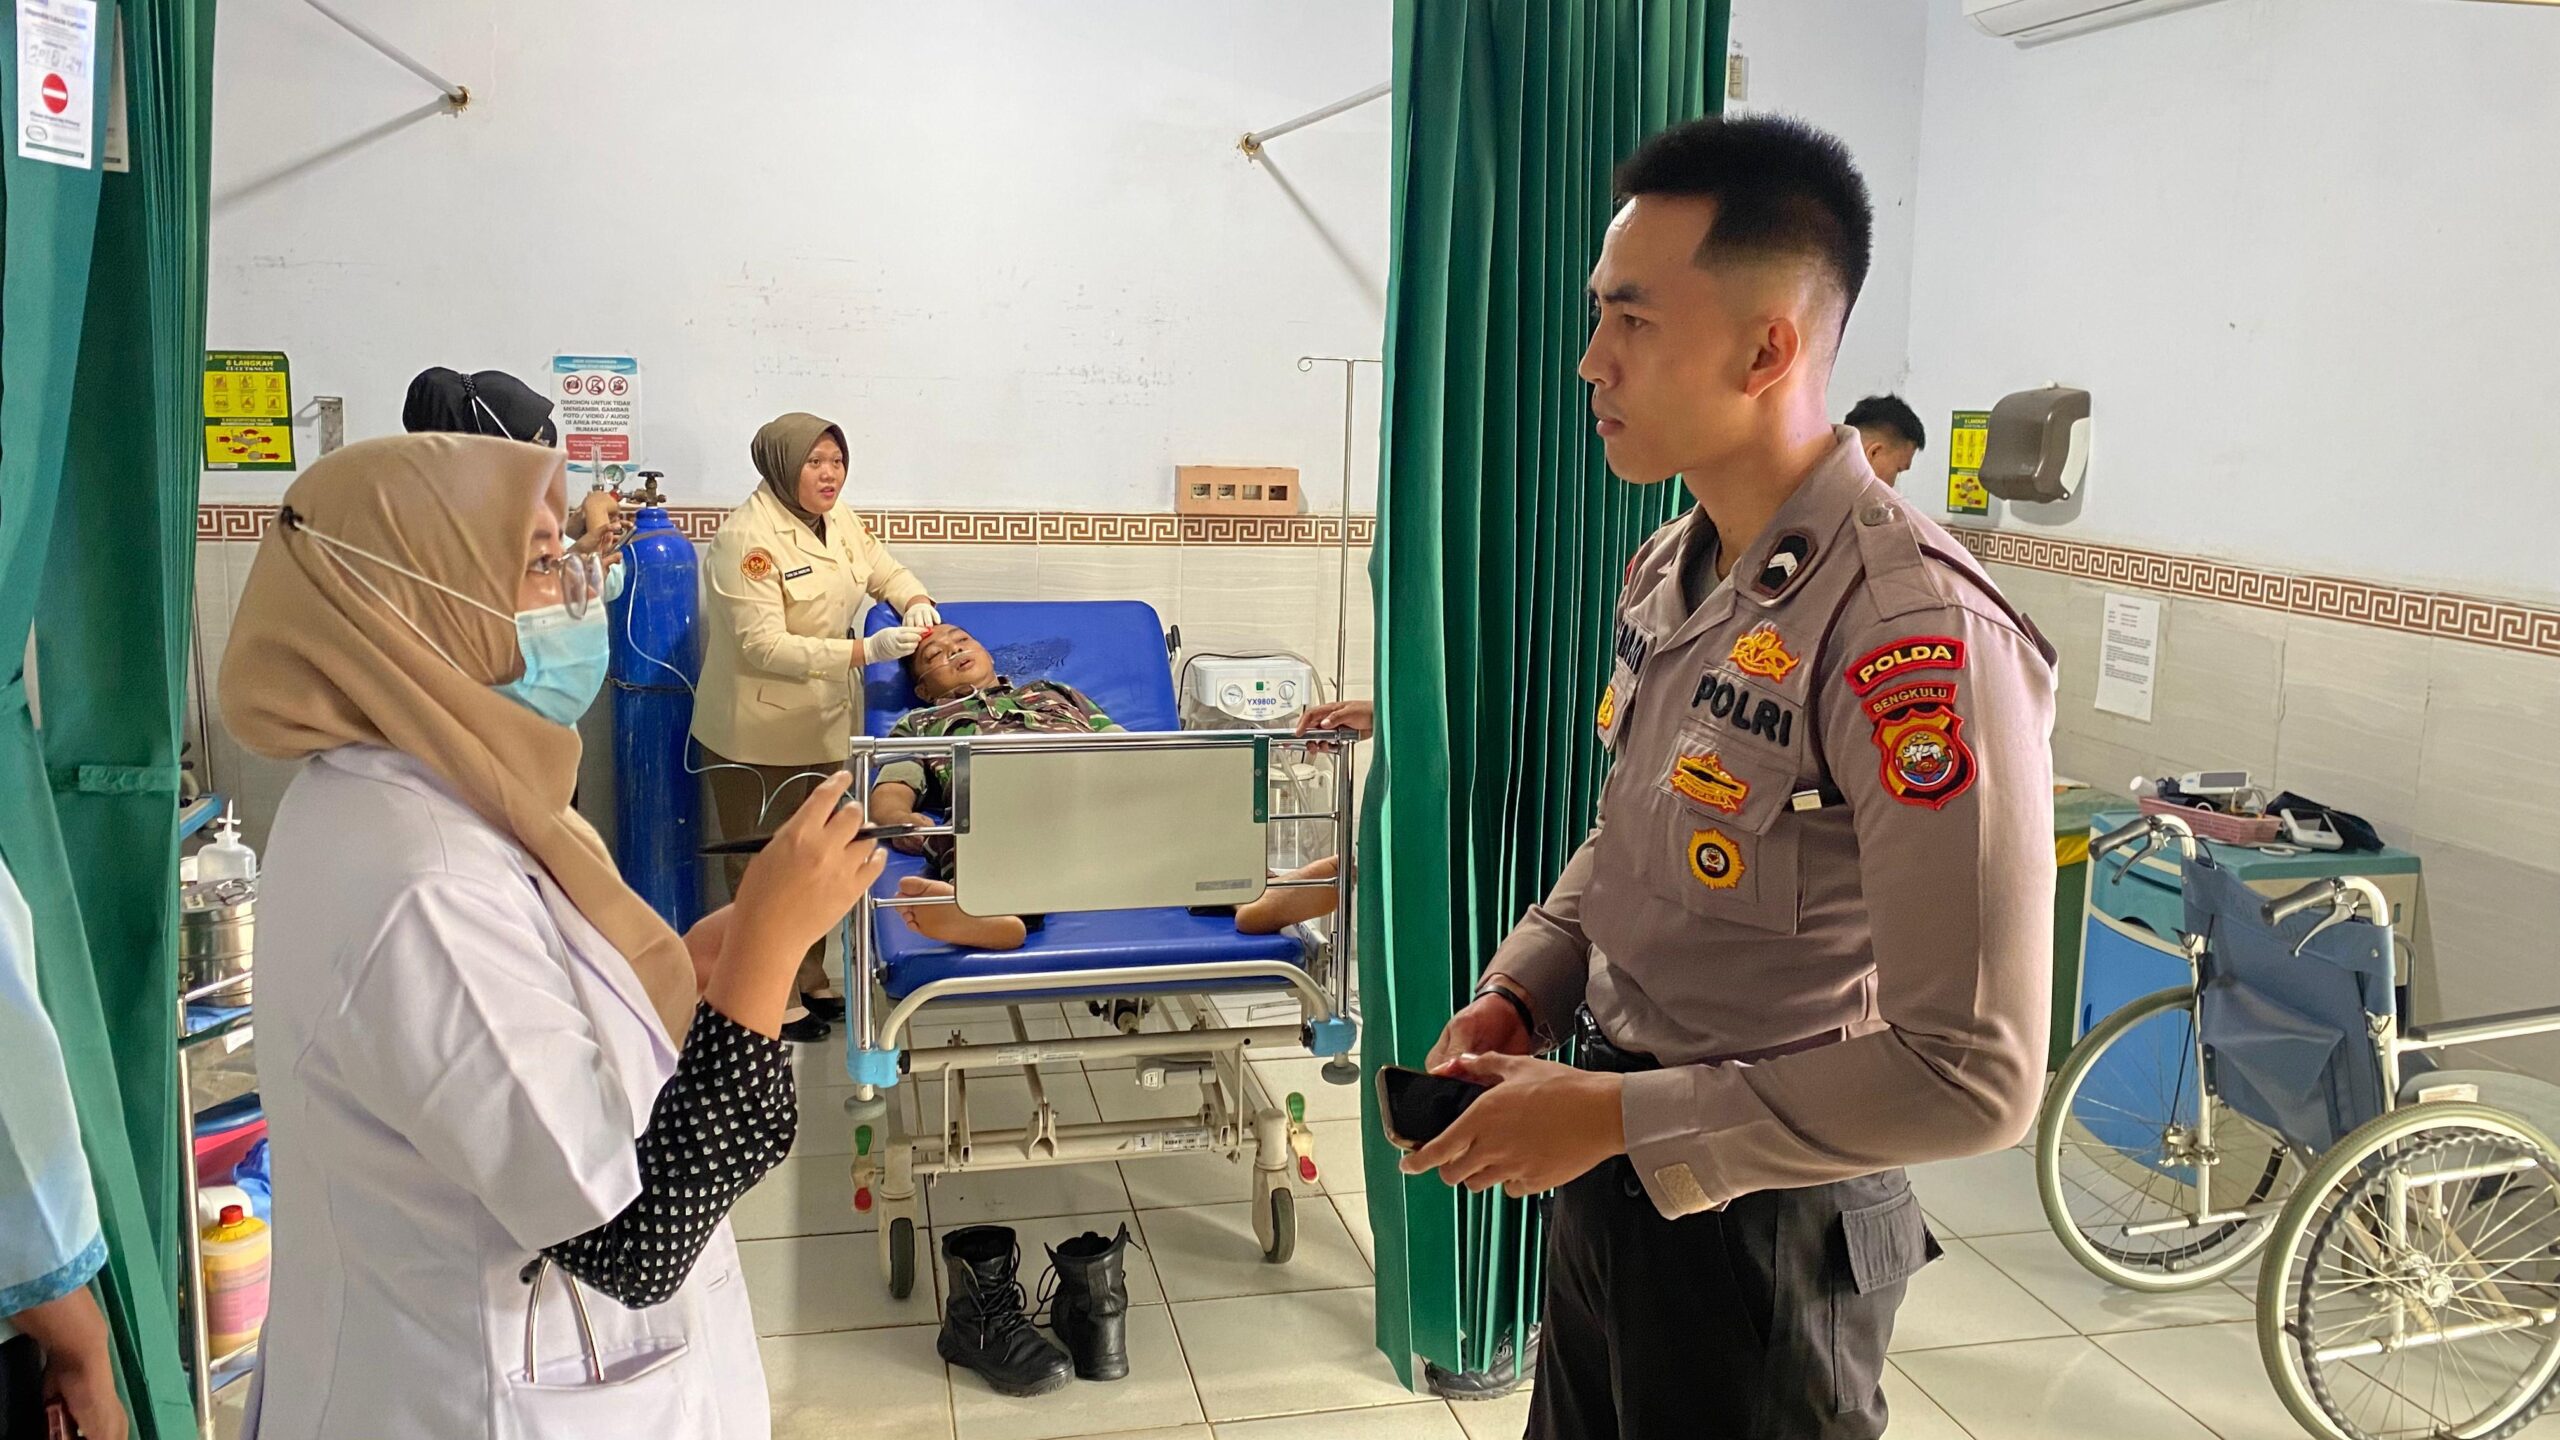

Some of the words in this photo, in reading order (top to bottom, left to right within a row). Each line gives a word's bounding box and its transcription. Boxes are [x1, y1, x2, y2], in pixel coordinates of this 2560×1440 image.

[1859, 645, 1952, 683] POLDA
[1692, 673, 1793, 747] POLRI
[1872, 687, 1948, 713] BENGKULU
[1141, 1137, 1147, 1148] 1
